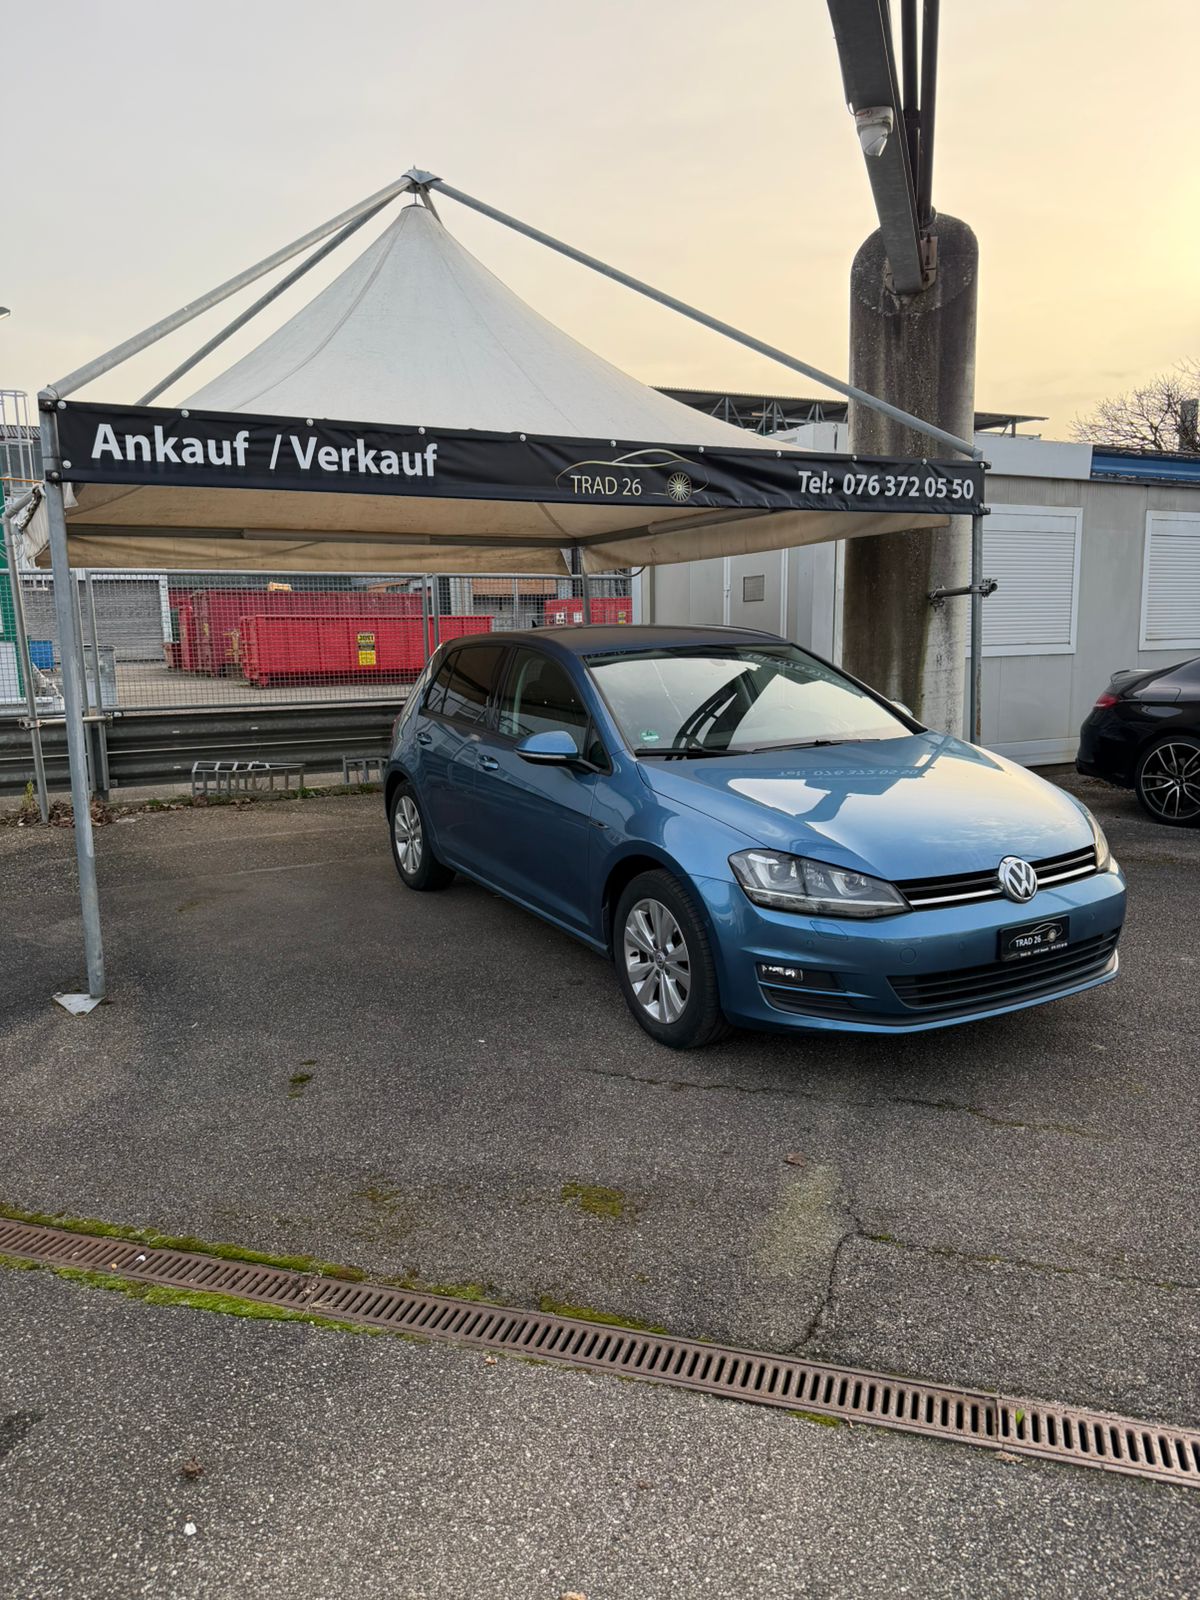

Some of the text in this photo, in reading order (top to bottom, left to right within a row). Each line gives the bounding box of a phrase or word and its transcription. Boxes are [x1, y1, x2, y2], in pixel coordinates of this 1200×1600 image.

[91, 423, 250, 467] Ankauf
[570, 475, 642, 496] TRAD 26
[798, 470, 974, 499] Tel: 076 372 05 50
[1015, 934, 1042, 947] TRAD 26
